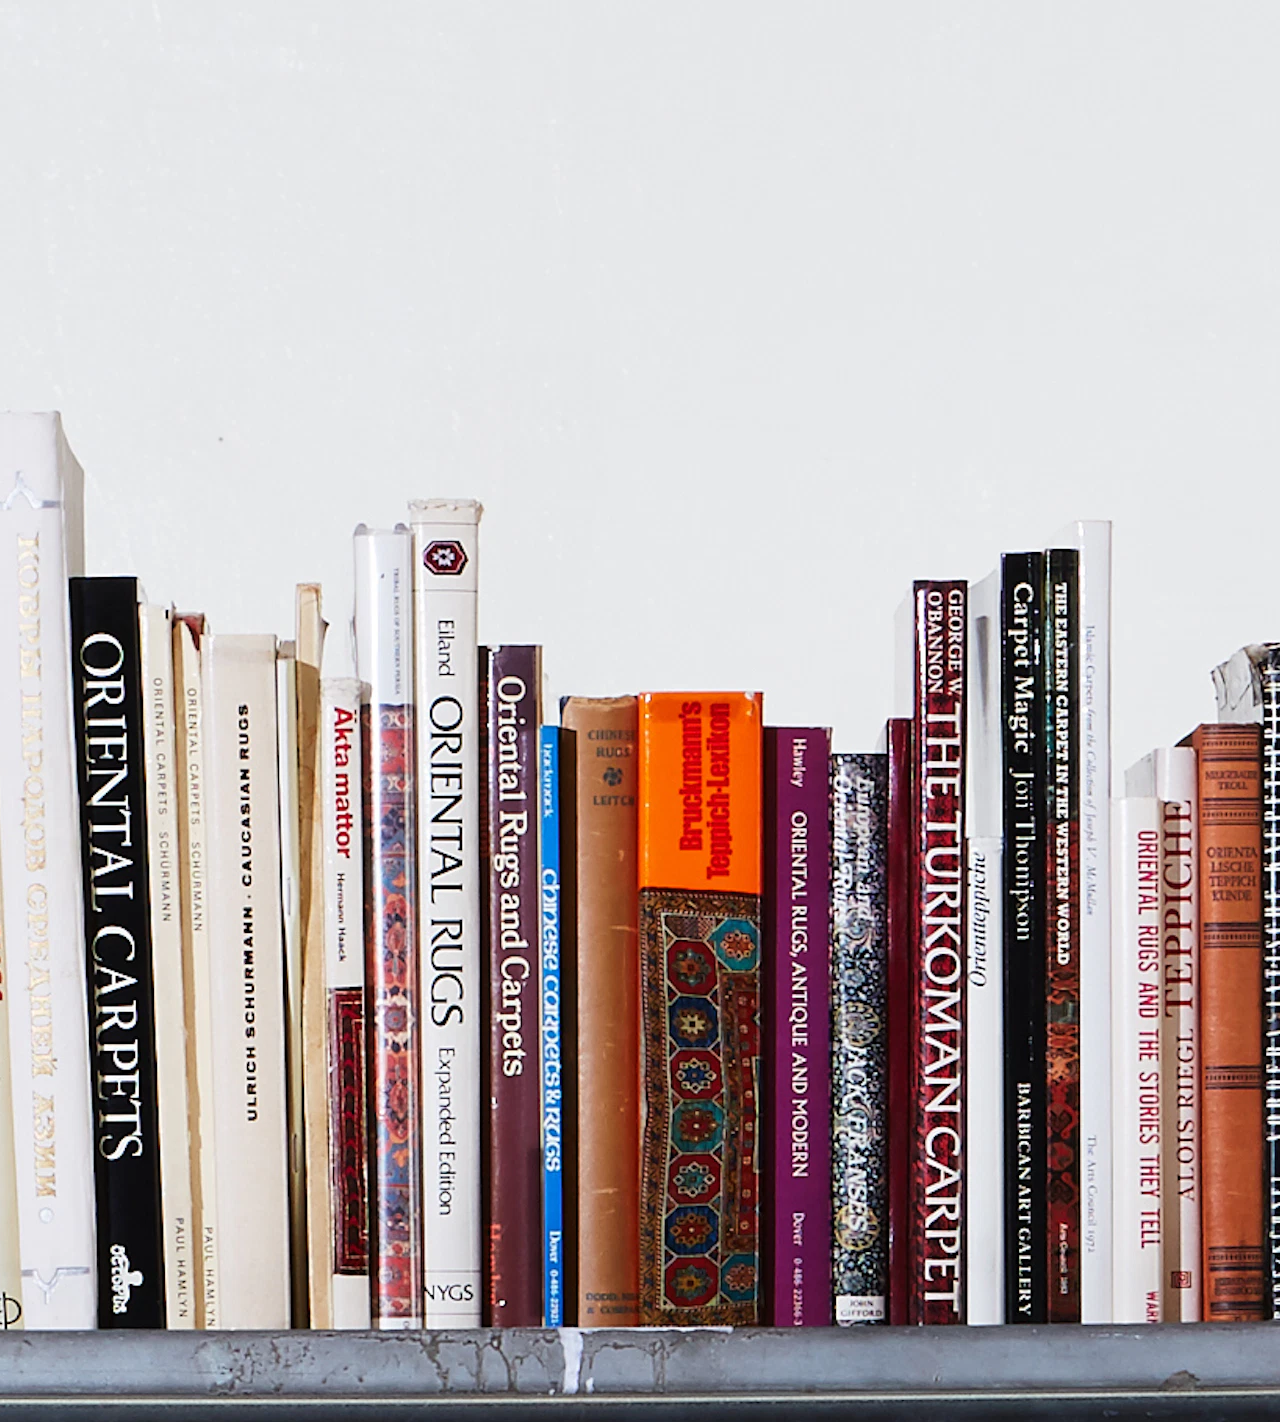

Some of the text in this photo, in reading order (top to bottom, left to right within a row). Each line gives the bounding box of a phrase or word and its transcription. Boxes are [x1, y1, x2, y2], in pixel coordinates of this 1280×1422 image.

[926, 590, 943, 693] O'BANNON
[945, 588, 964, 696] GEORGE W.
[1054, 582, 1070, 965] THE EASTERN CARPET IN THE WESTERN WORLD
[80, 633, 142, 1161] ORIENTAL CARPETS
[331, 705, 358, 963] Äkta mattor Hermann Haack
[429, 618, 464, 1215] Eiland ORIENTAL RUGS Expanded Edition
[922, 702, 961, 1312] THE TURKOMAN CARPET
